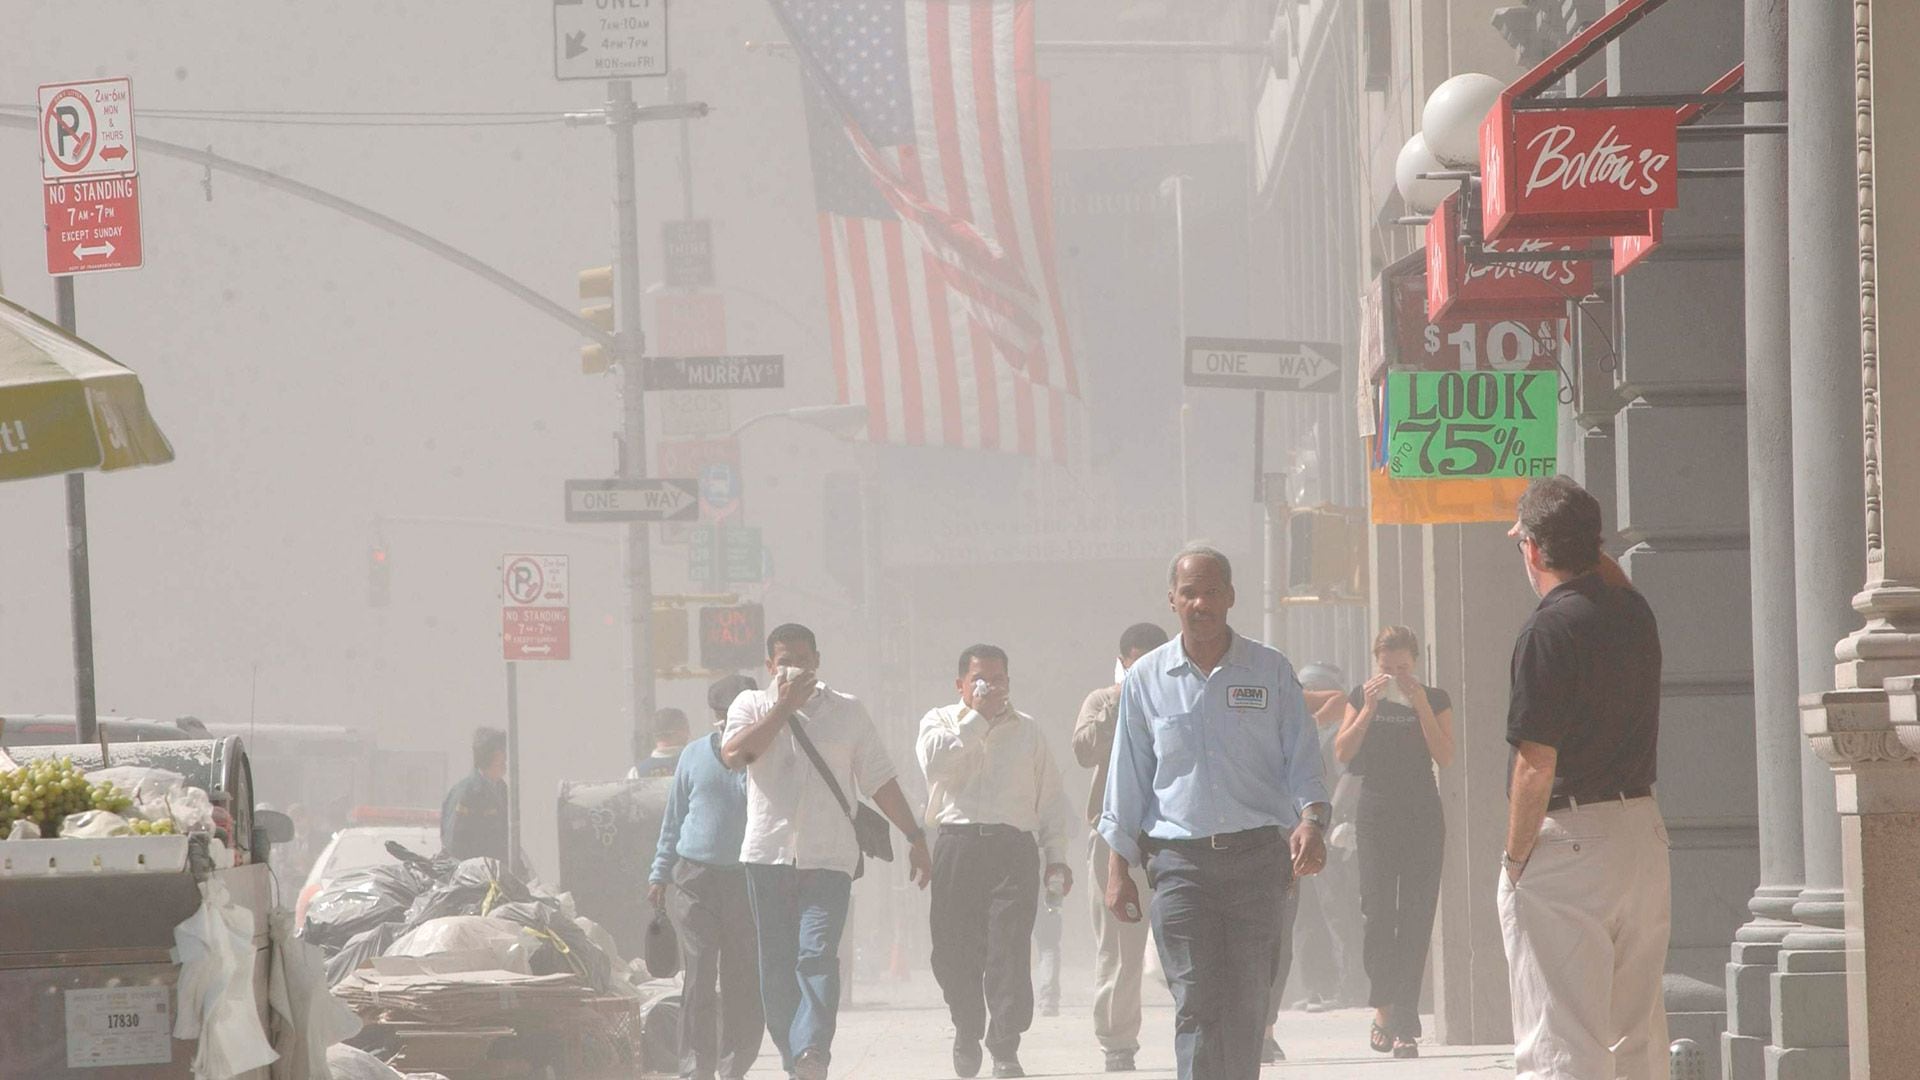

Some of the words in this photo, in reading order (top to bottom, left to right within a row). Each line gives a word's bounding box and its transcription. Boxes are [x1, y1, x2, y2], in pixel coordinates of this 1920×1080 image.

[103, 105, 118, 115] MON
[109, 118, 114, 128] &
[101, 130, 124, 141] THURS
[1525, 125, 1669, 198] Bolton's
[50, 186, 65, 204] NO
[74, 179, 133, 202] STANDING
[61, 230, 89, 242] EXCEPT
[94, 226, 122, 239] SUNDAY
[1206, 353, 1248, 373] ONE
[1279, 357, 1322, 377] WAY
[688, 364, 763, 385] MURRAY
[766, 364, 780, 376] ST
[1408, 373, 1538, 420] LOOK
[1393, 419, 1525, 475] 75%
[1514, 457, 1556, 477] OFF
[583, 492, 619, 509] ONE
[644, 492, 683, 508] WAY
[506, 611, 518, 621] NO
[523, 610, 567, 622] STANDING
[1236, 688, 1263, 699] ABM
[108, 1013, 139, 1028] 17830
